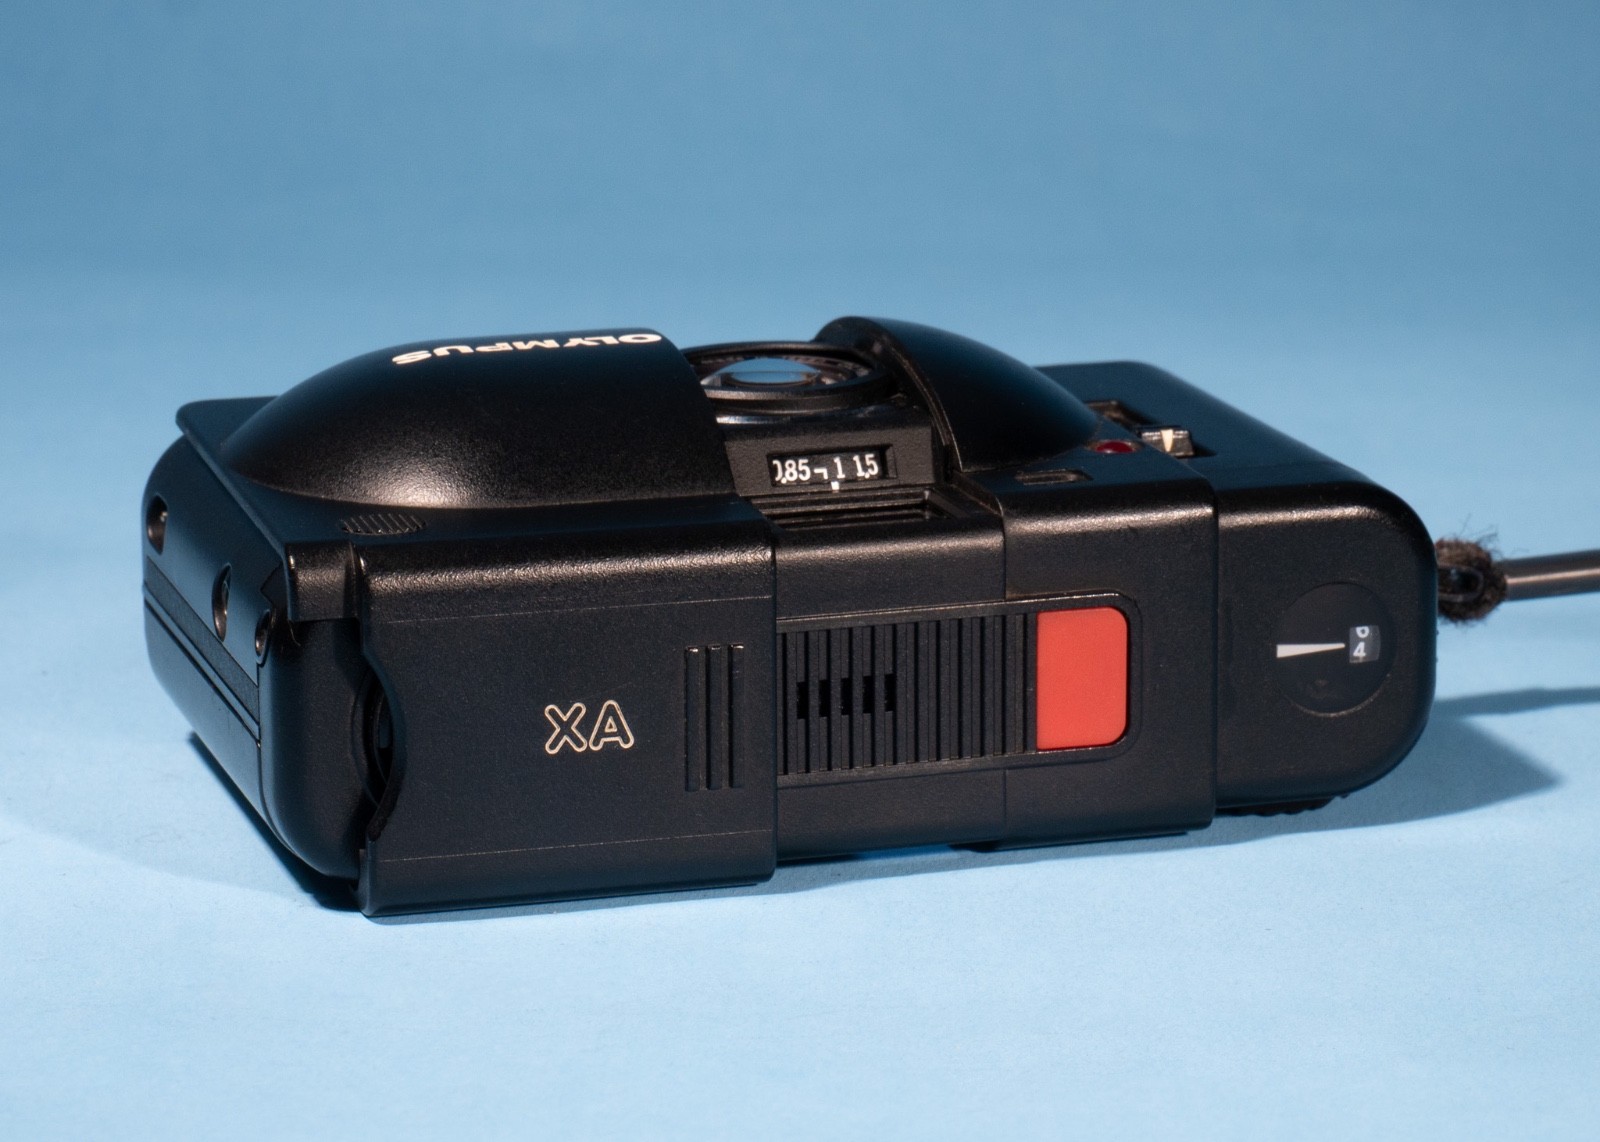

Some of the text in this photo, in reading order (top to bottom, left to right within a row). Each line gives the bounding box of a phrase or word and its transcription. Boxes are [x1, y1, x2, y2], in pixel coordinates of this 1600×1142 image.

[392, 332, 662, 365] OLYMPUS
[833, 456, 846, 479] 1
[852, 453, 879, 479] 1.5
[1352, 641, 1367, 663] 4
[544, 699, 635, 755] XA
